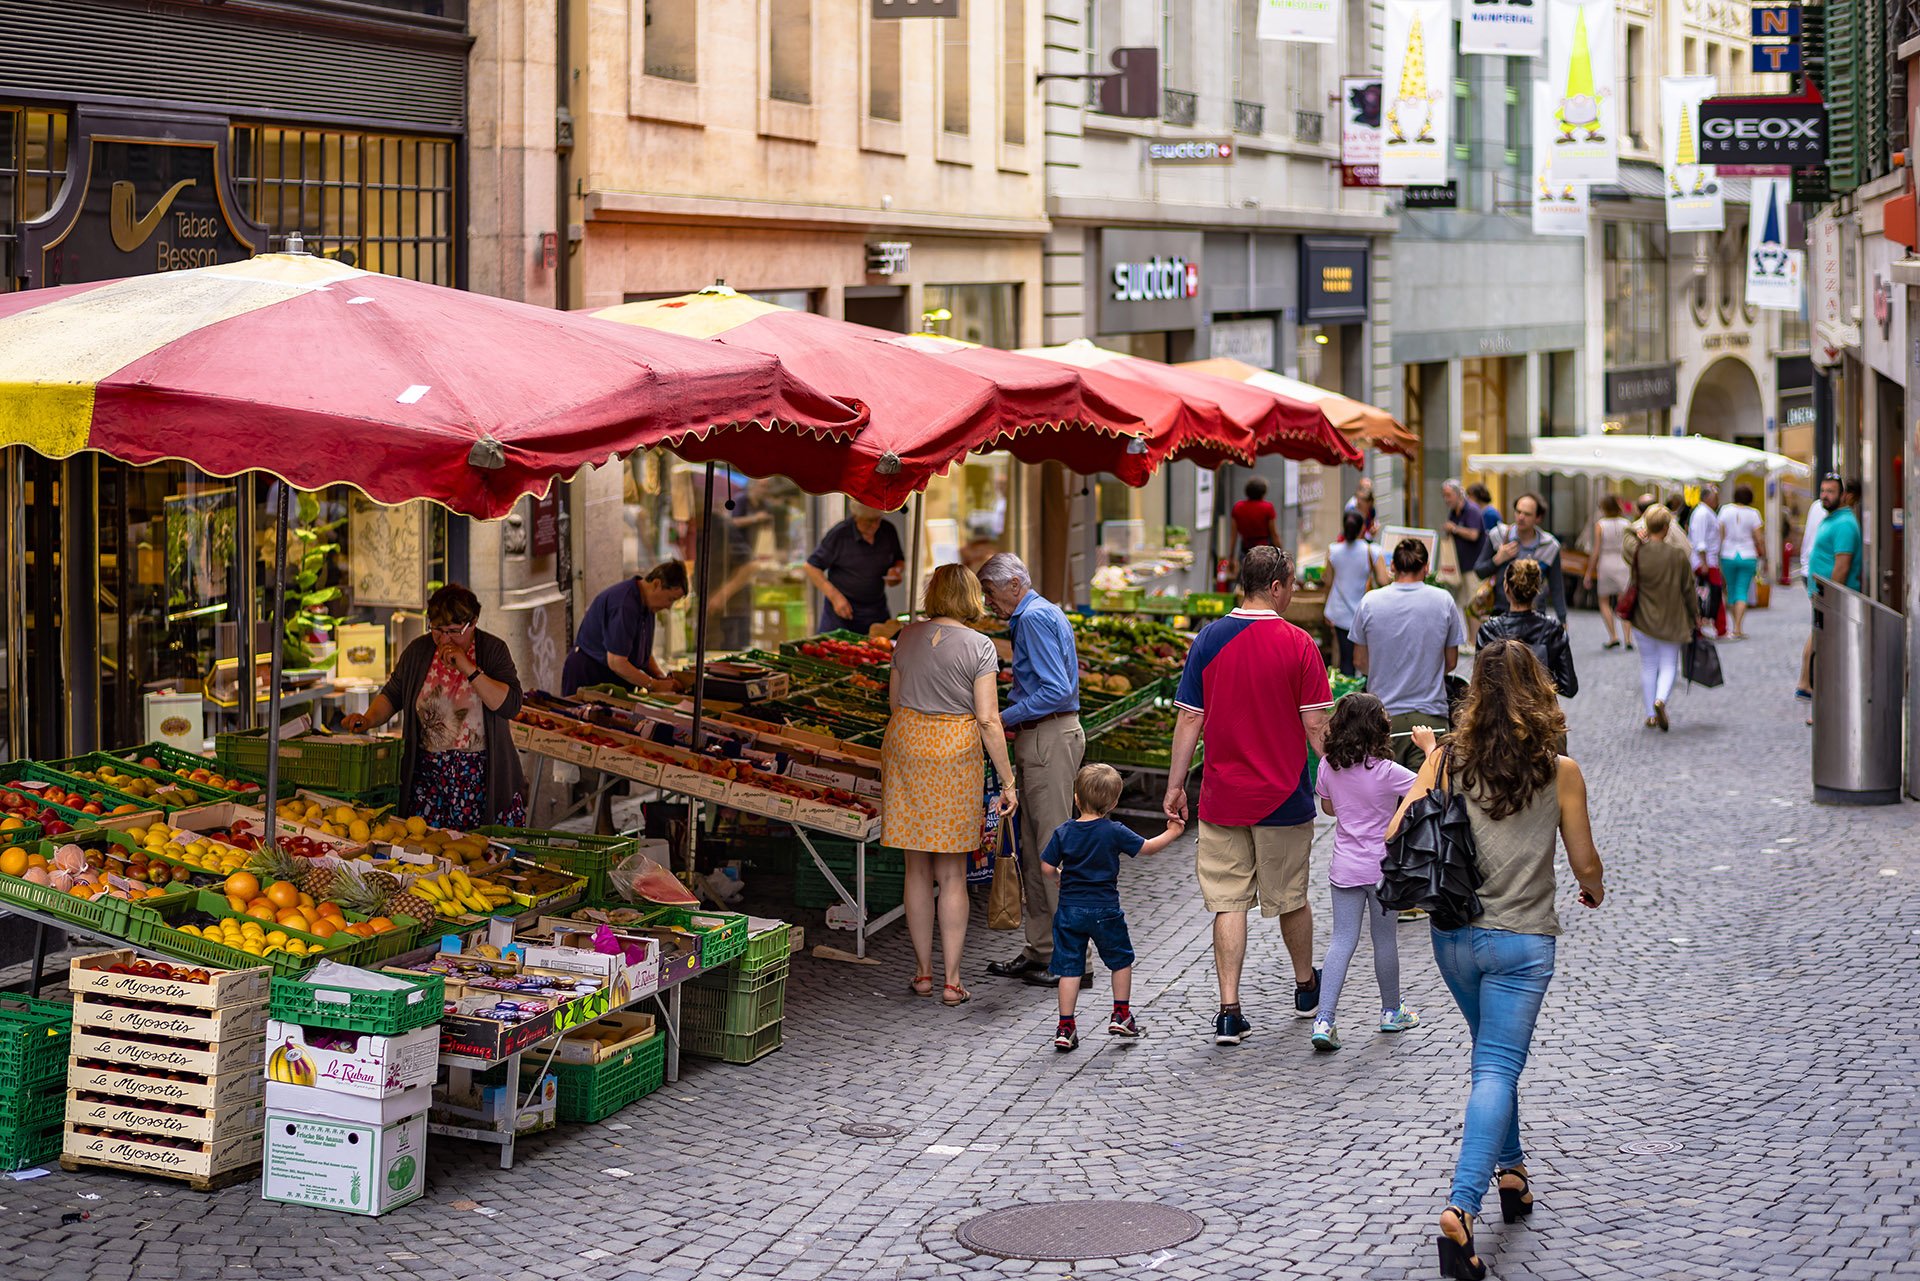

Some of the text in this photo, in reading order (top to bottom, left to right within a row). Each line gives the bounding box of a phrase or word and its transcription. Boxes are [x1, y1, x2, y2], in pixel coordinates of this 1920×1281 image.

[1702, 117, 1820, 139] GEOX
[1150, 142, 1219, 158] swatch
[1702, 140, 1819, 151] RESPIRA
[175, 211, 218, 238] Tabac
[157, 241, 218, 271] Besson
[1824, 223, 1838, 311] PIZZA
[1115, 256, 1187, 301] swatch
[92, 975, 191, 998] Le Myosotis
[96, 1009, 195, 1033] Le Myosotis
[94, 1042, 193, 1065] Le Myosotis
[321, 1059, 374, 1083] Le Ruban
[90, 1074, 189, 1098] Le Myosotis
[89, 1107, 188, 1131] Le Myosotis
[86, 1140, 186, 1165] Le Myosotis
